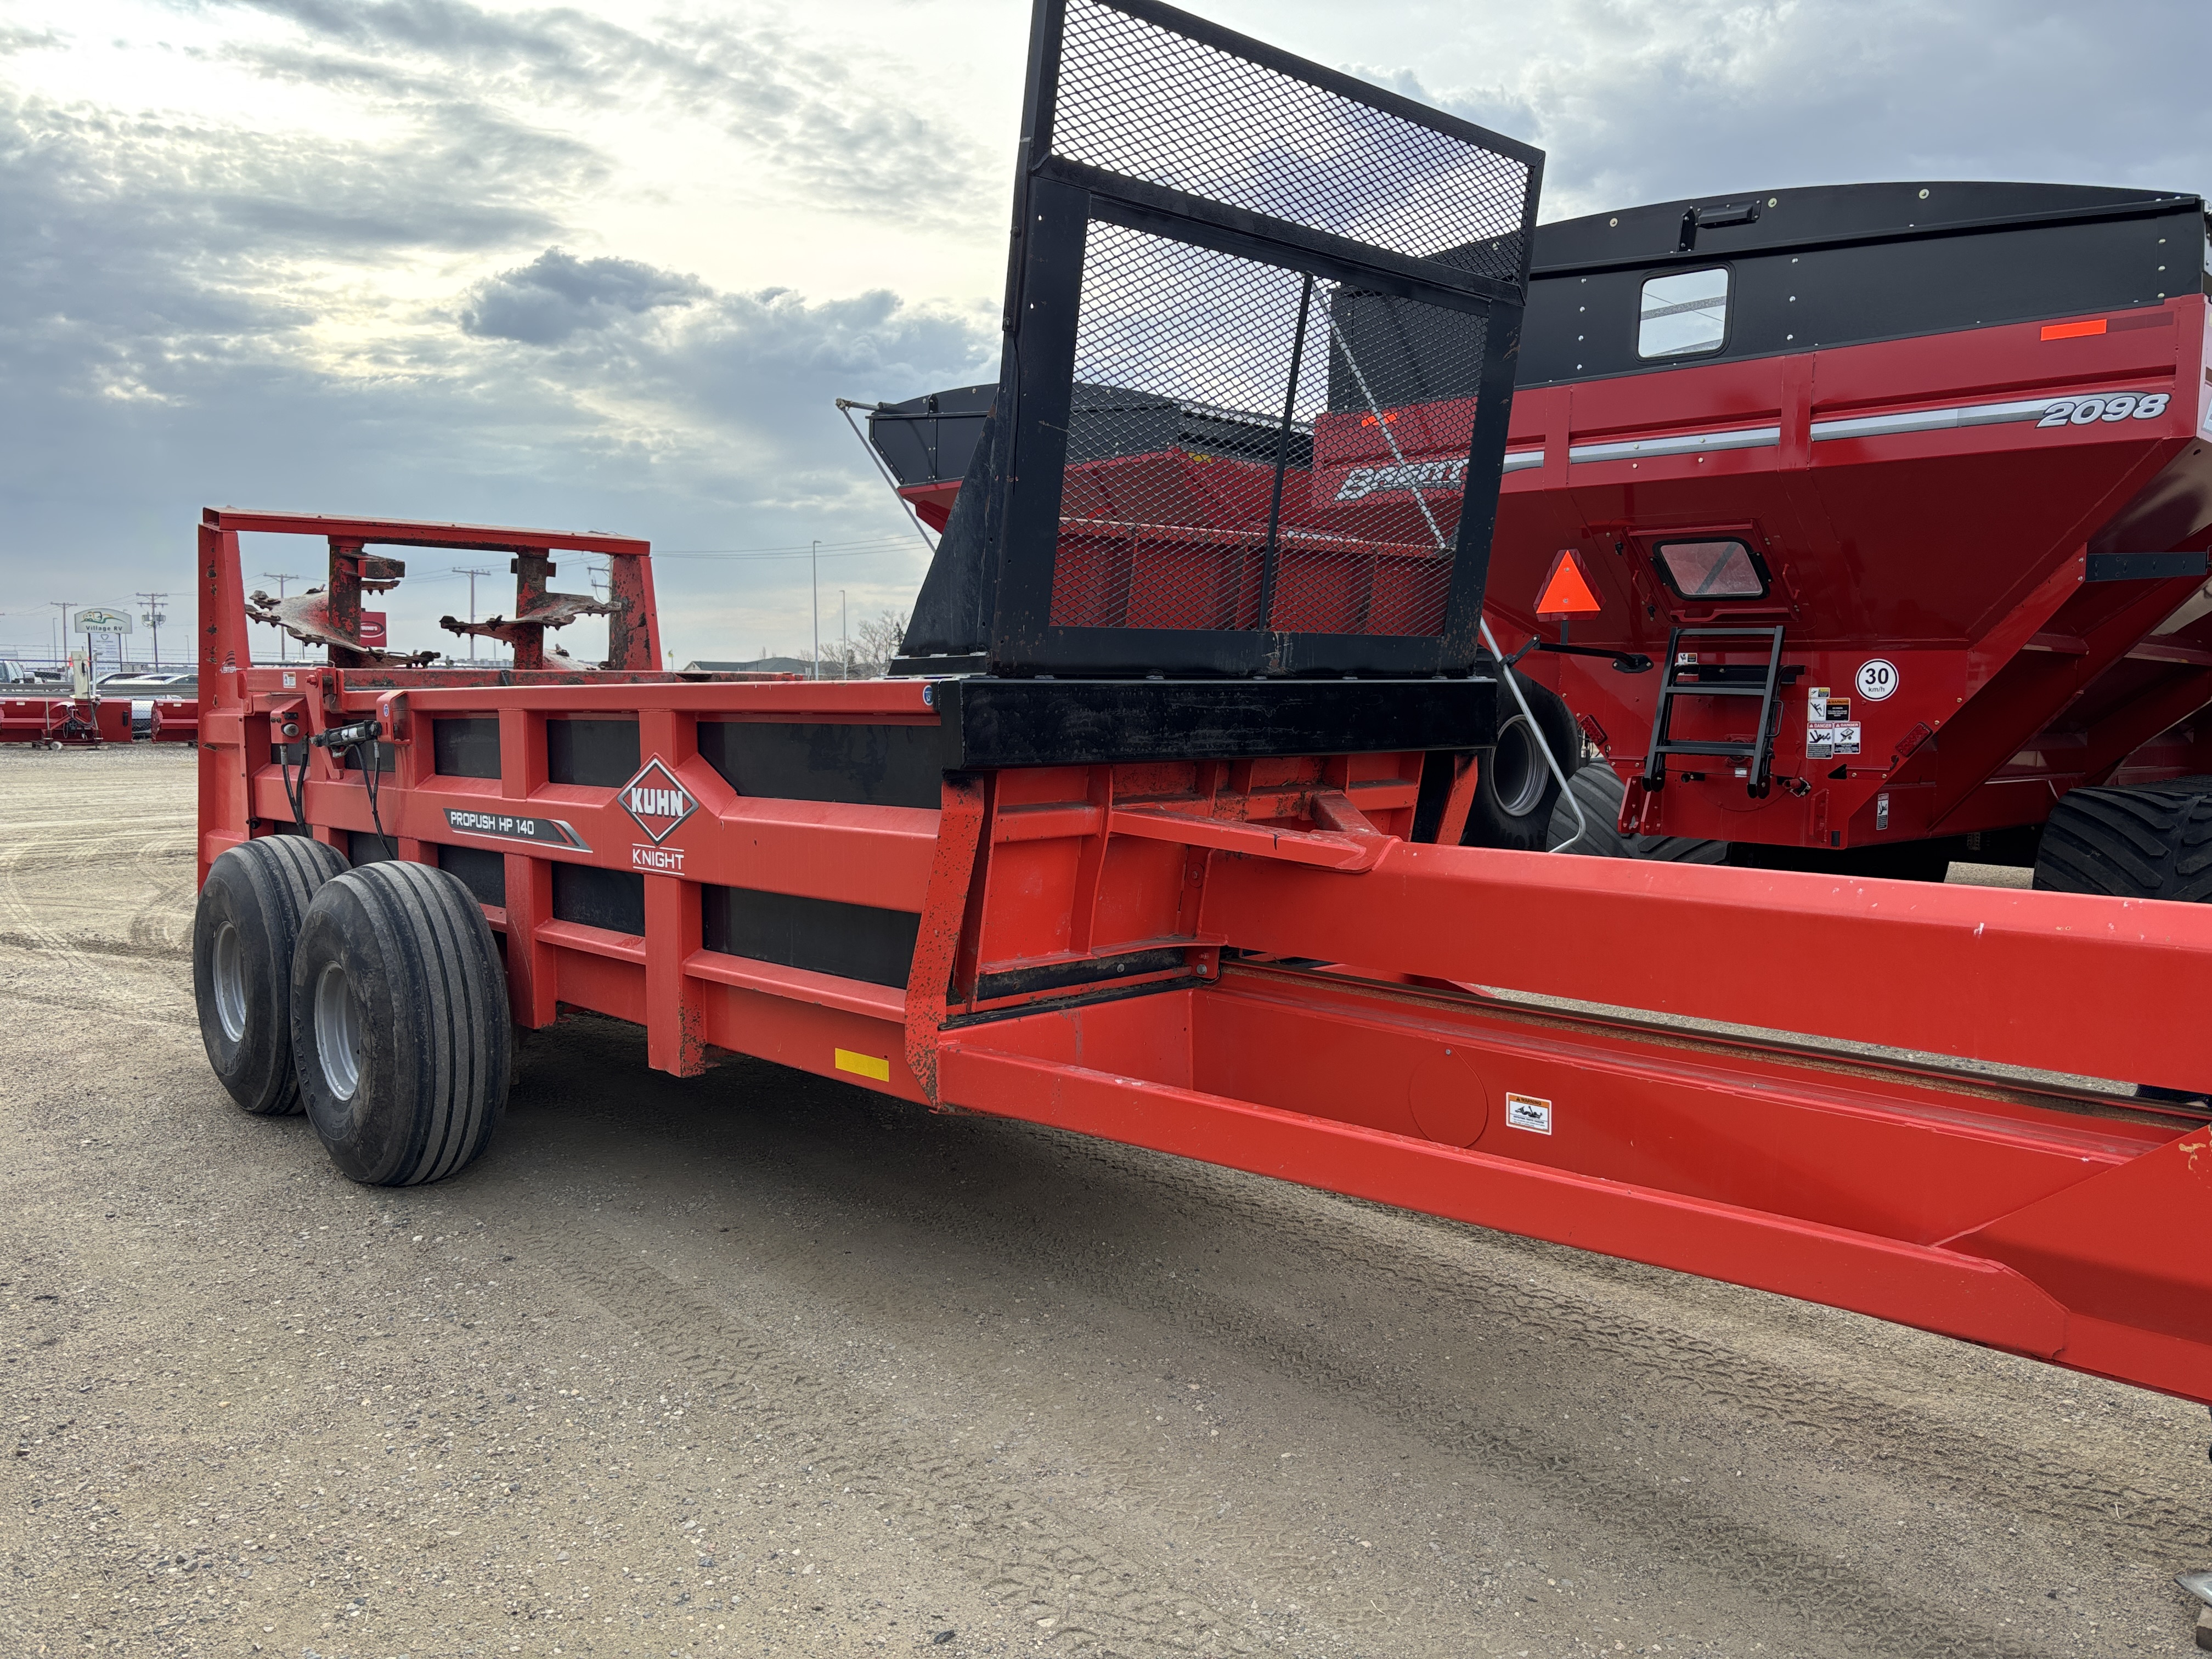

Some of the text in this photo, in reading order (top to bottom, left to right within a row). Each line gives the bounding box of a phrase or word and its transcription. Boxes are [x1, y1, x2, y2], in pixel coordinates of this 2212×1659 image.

[2034, 392, 2171, 429] 2098
[1865, 668, 1889, 685] 30
[631, 787, 684, 817] KUHN
[450, 811, 534, 836] PROPUSH HP 140
[633, 849, 685, 870] KNIGHT
[1521, 1097, 1542, 1106] WARNING
